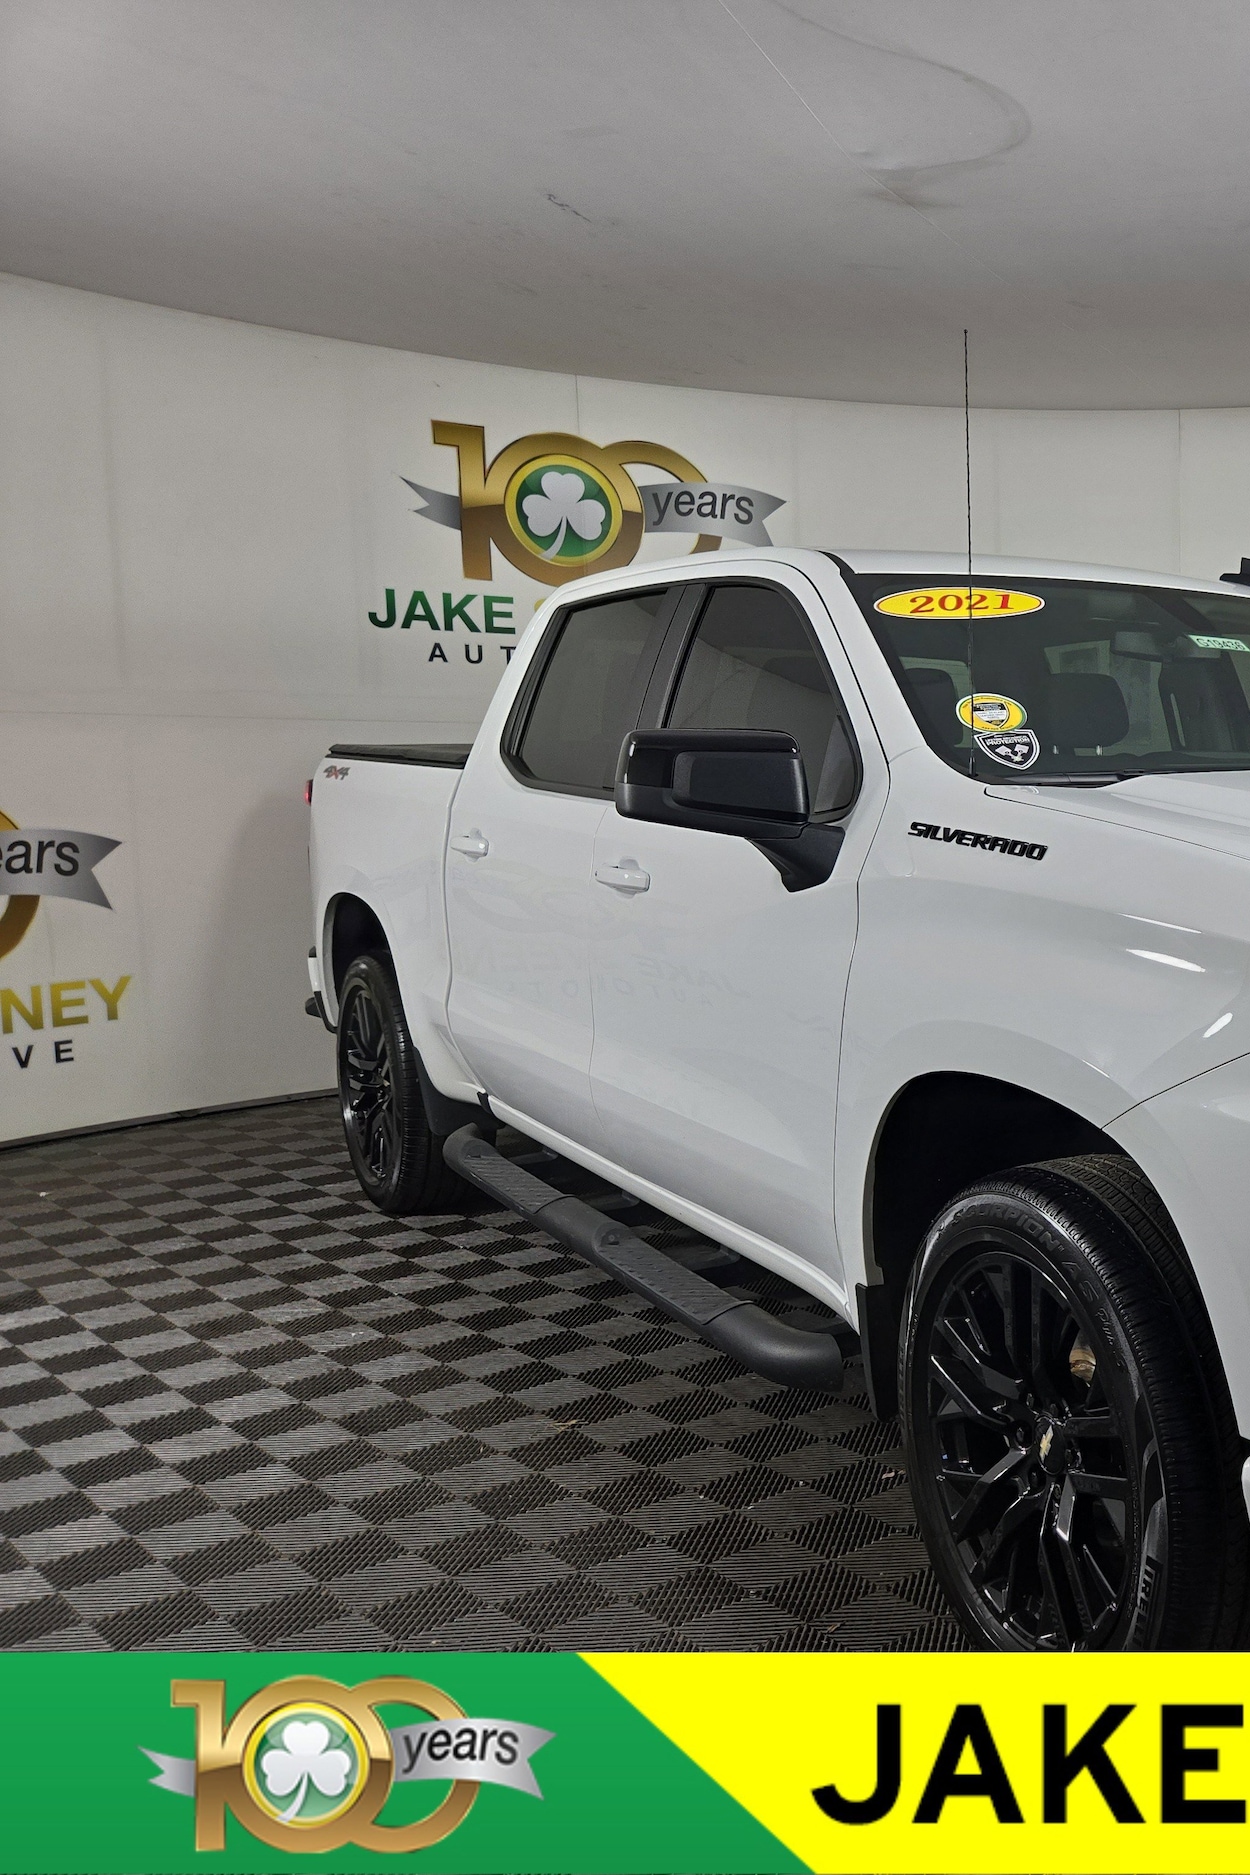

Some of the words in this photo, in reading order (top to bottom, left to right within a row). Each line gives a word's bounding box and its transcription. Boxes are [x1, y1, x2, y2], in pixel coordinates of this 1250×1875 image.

[651, 490, 754, 526] years
[368, 588, 516, 635] JAKE
[909, 593, 1014, 614] 2021
[0, 840, 80, 876] ars
[908, 821, 1048, 861] SILVERADO
